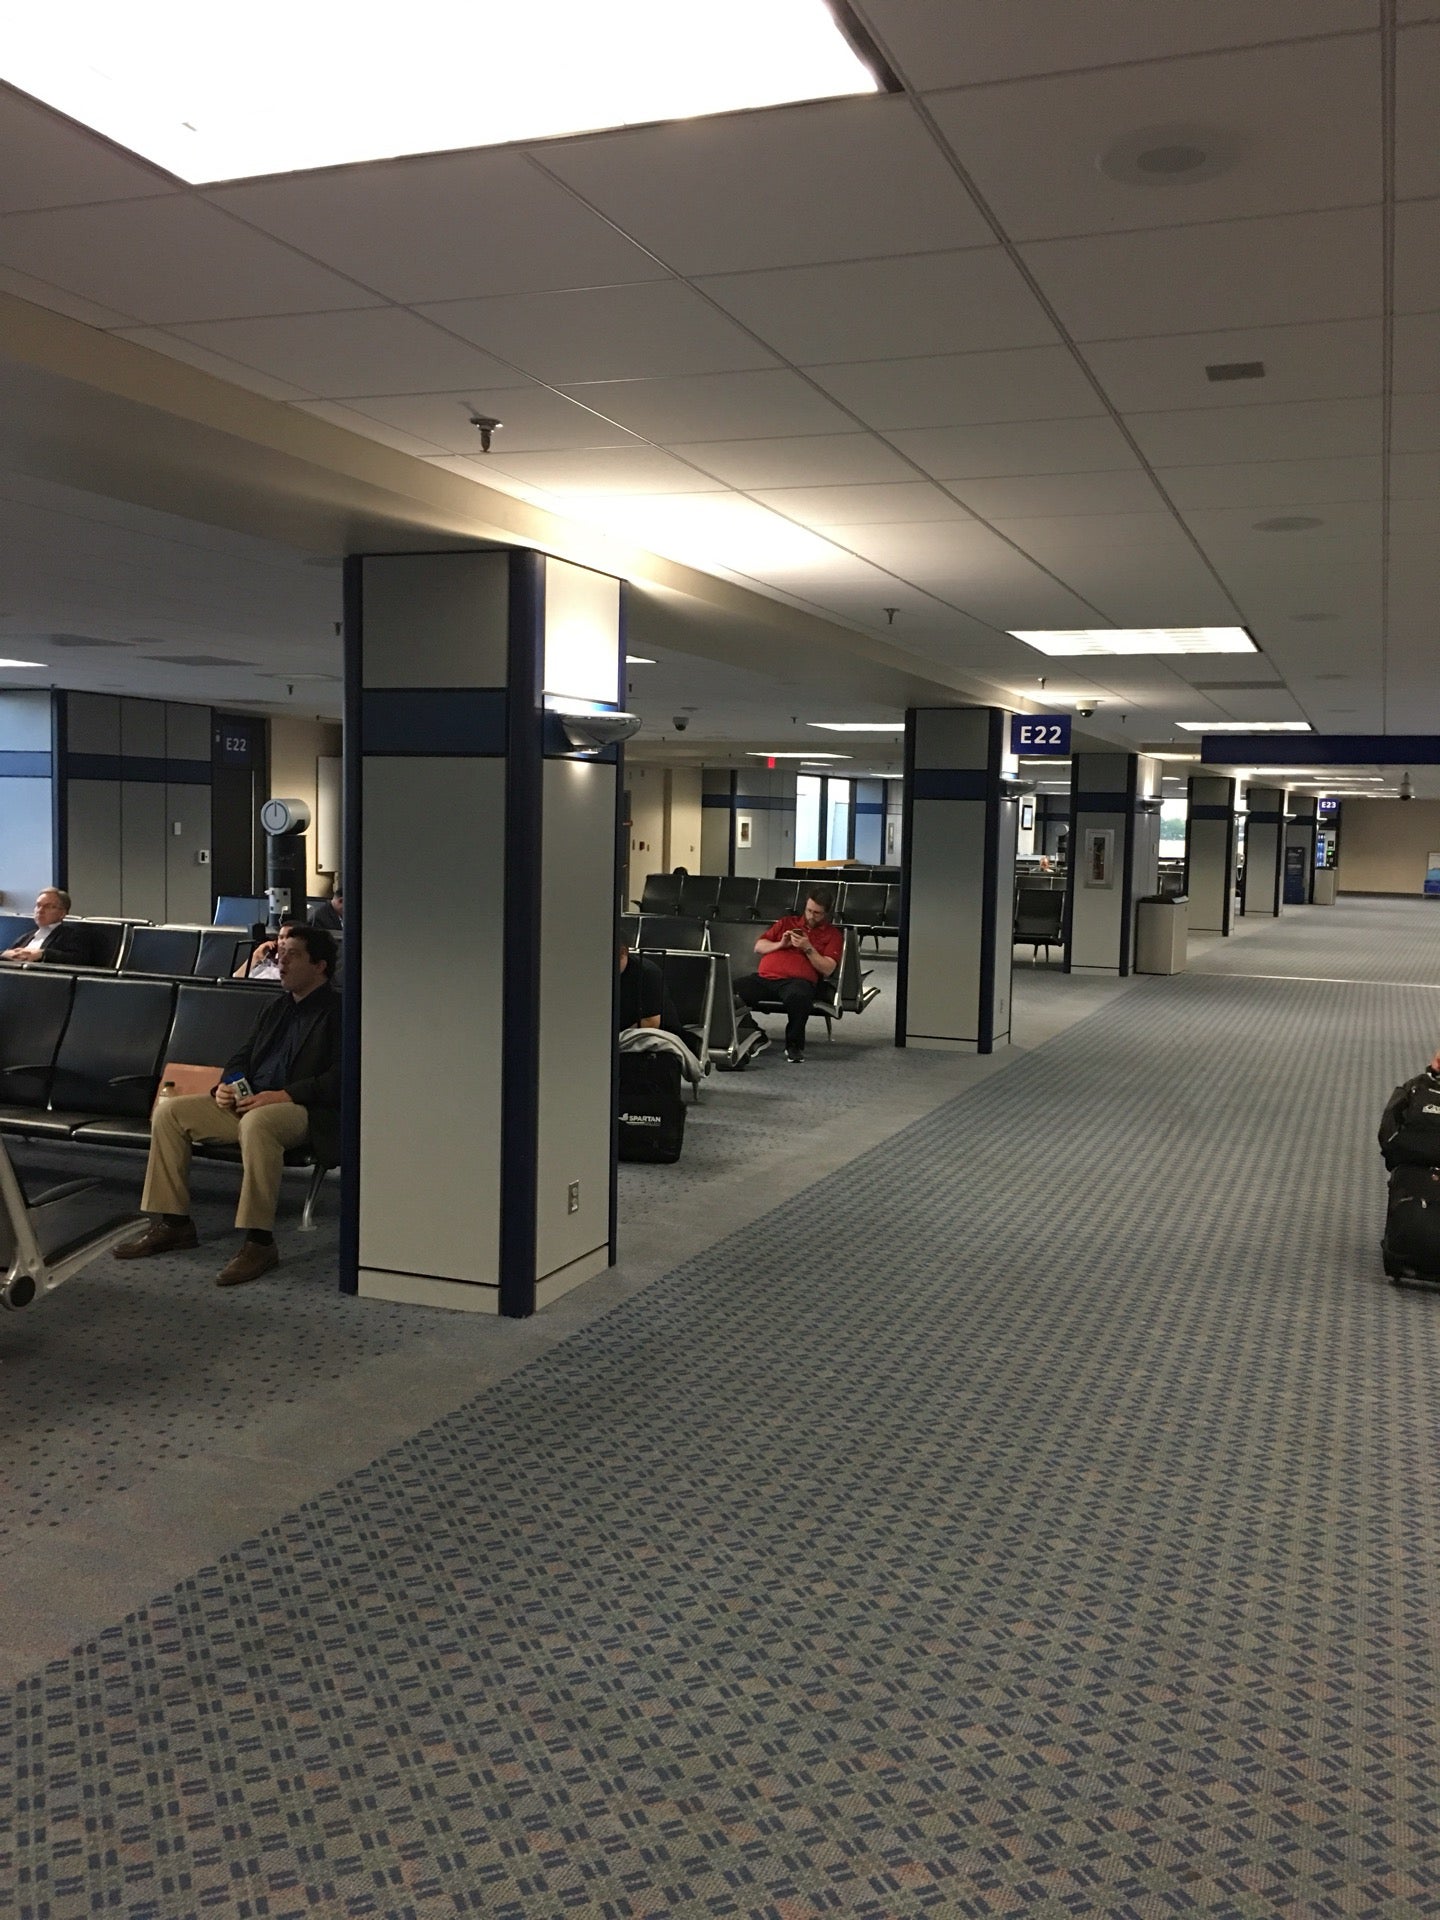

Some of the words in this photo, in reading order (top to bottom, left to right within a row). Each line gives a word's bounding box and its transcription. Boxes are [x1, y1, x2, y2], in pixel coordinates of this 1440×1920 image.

[1020, 725, 1062, 744] E22
[226, 737, 247, 752] E22
[1321, 801, 1337, 809] E23
[629, 1115, 661, 1123] SPARTAN
